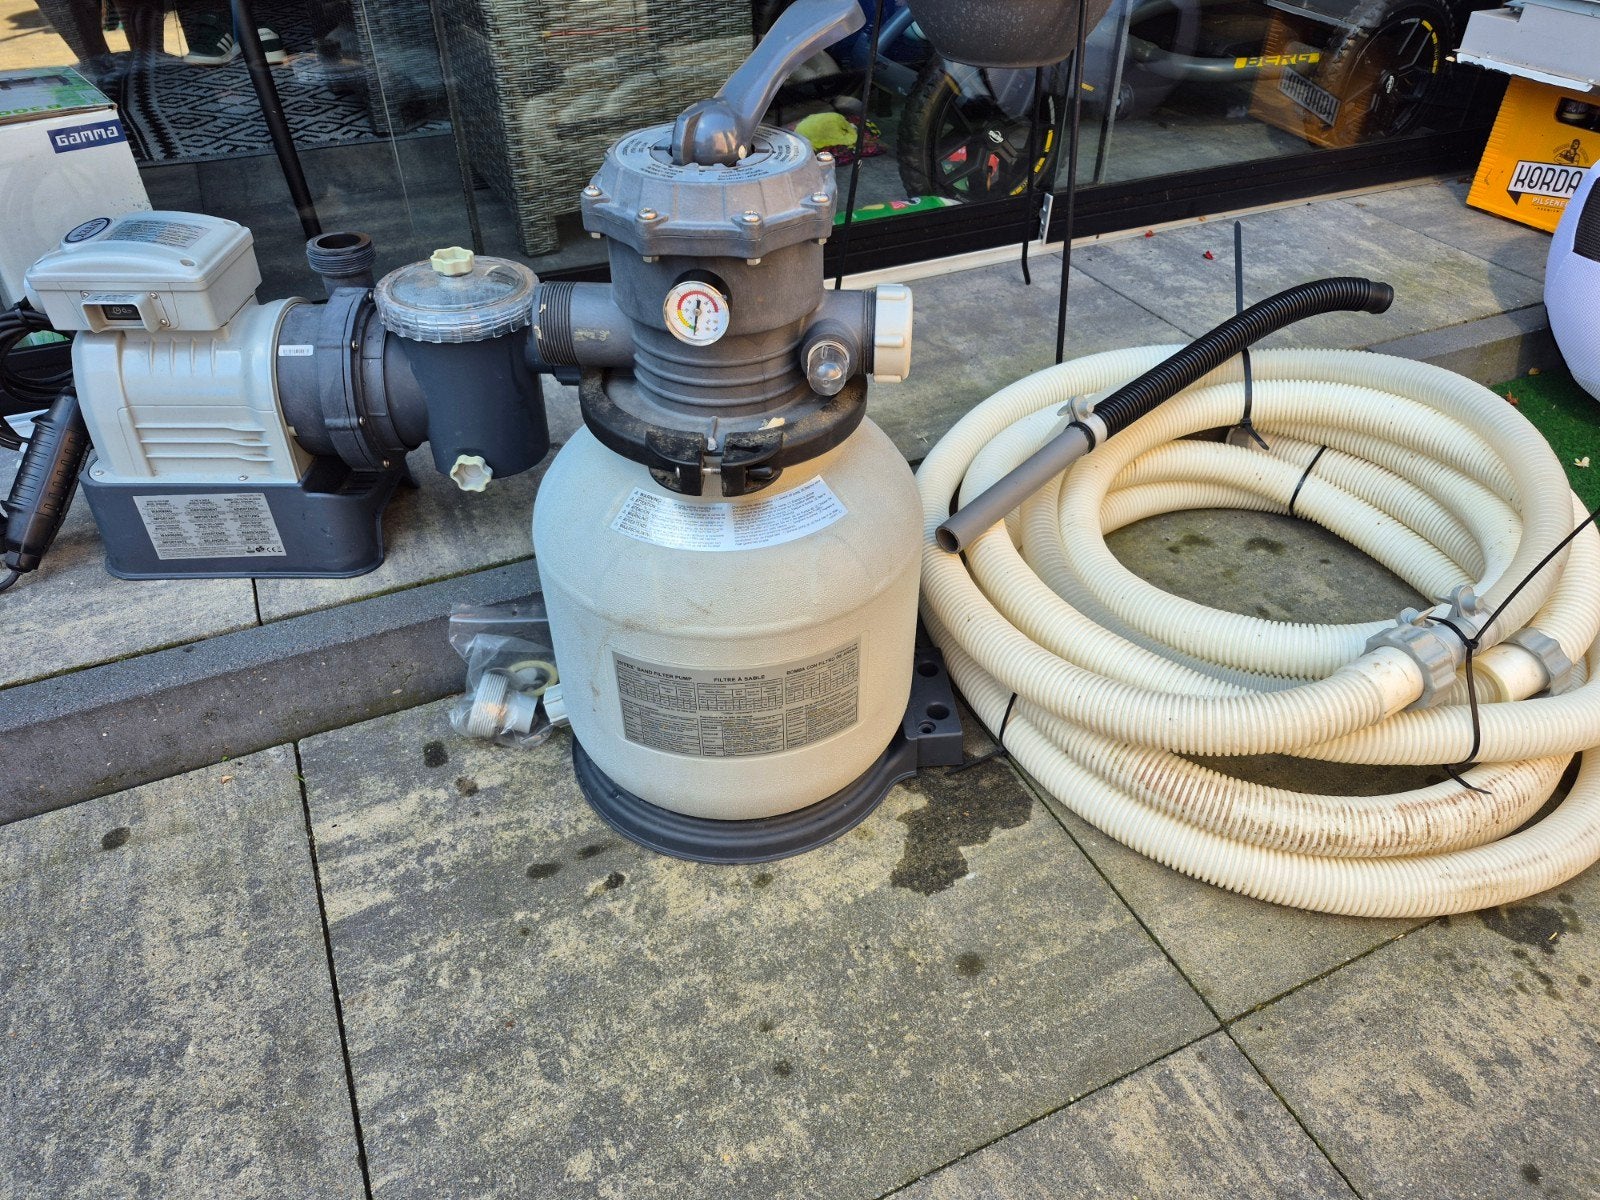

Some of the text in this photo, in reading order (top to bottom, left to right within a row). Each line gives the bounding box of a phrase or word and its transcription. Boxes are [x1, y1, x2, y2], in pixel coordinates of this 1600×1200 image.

[1242, 52, 1314, 69] BERG
[1531, 197, 1569, 207] PILSENE
[637, 666, 653, 676] SAND
[653, 671, 674, 679] FILTER
[786, 667, 806, 675] BOMBA
[806, 663, 818, 671] CON
